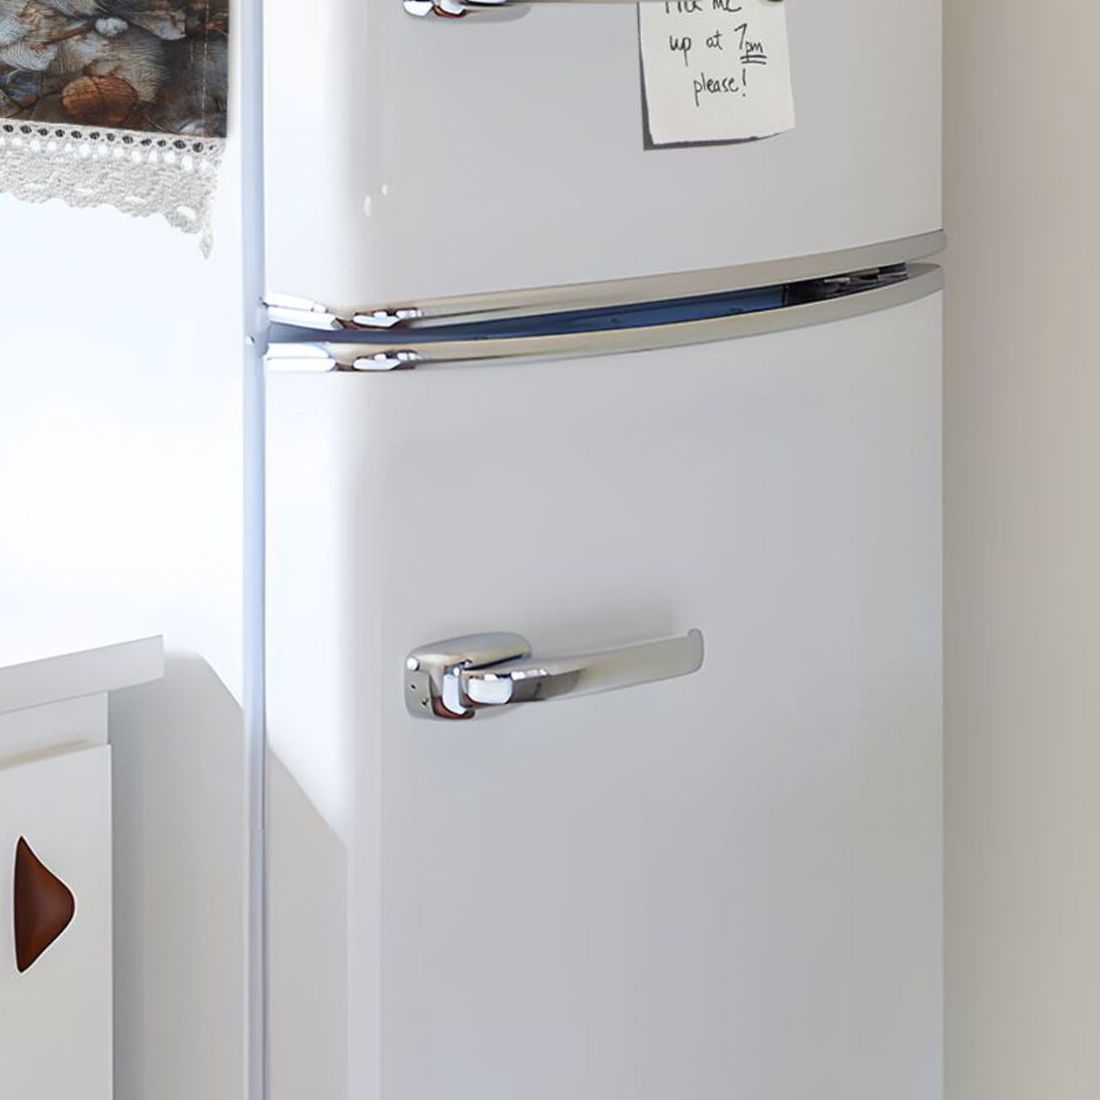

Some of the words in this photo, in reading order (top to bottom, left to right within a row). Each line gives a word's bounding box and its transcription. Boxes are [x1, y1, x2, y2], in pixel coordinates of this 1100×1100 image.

[668, 34, 693, 68] up
[705, 29, 724, 51] at
[692, 68, 748, 108] please!
